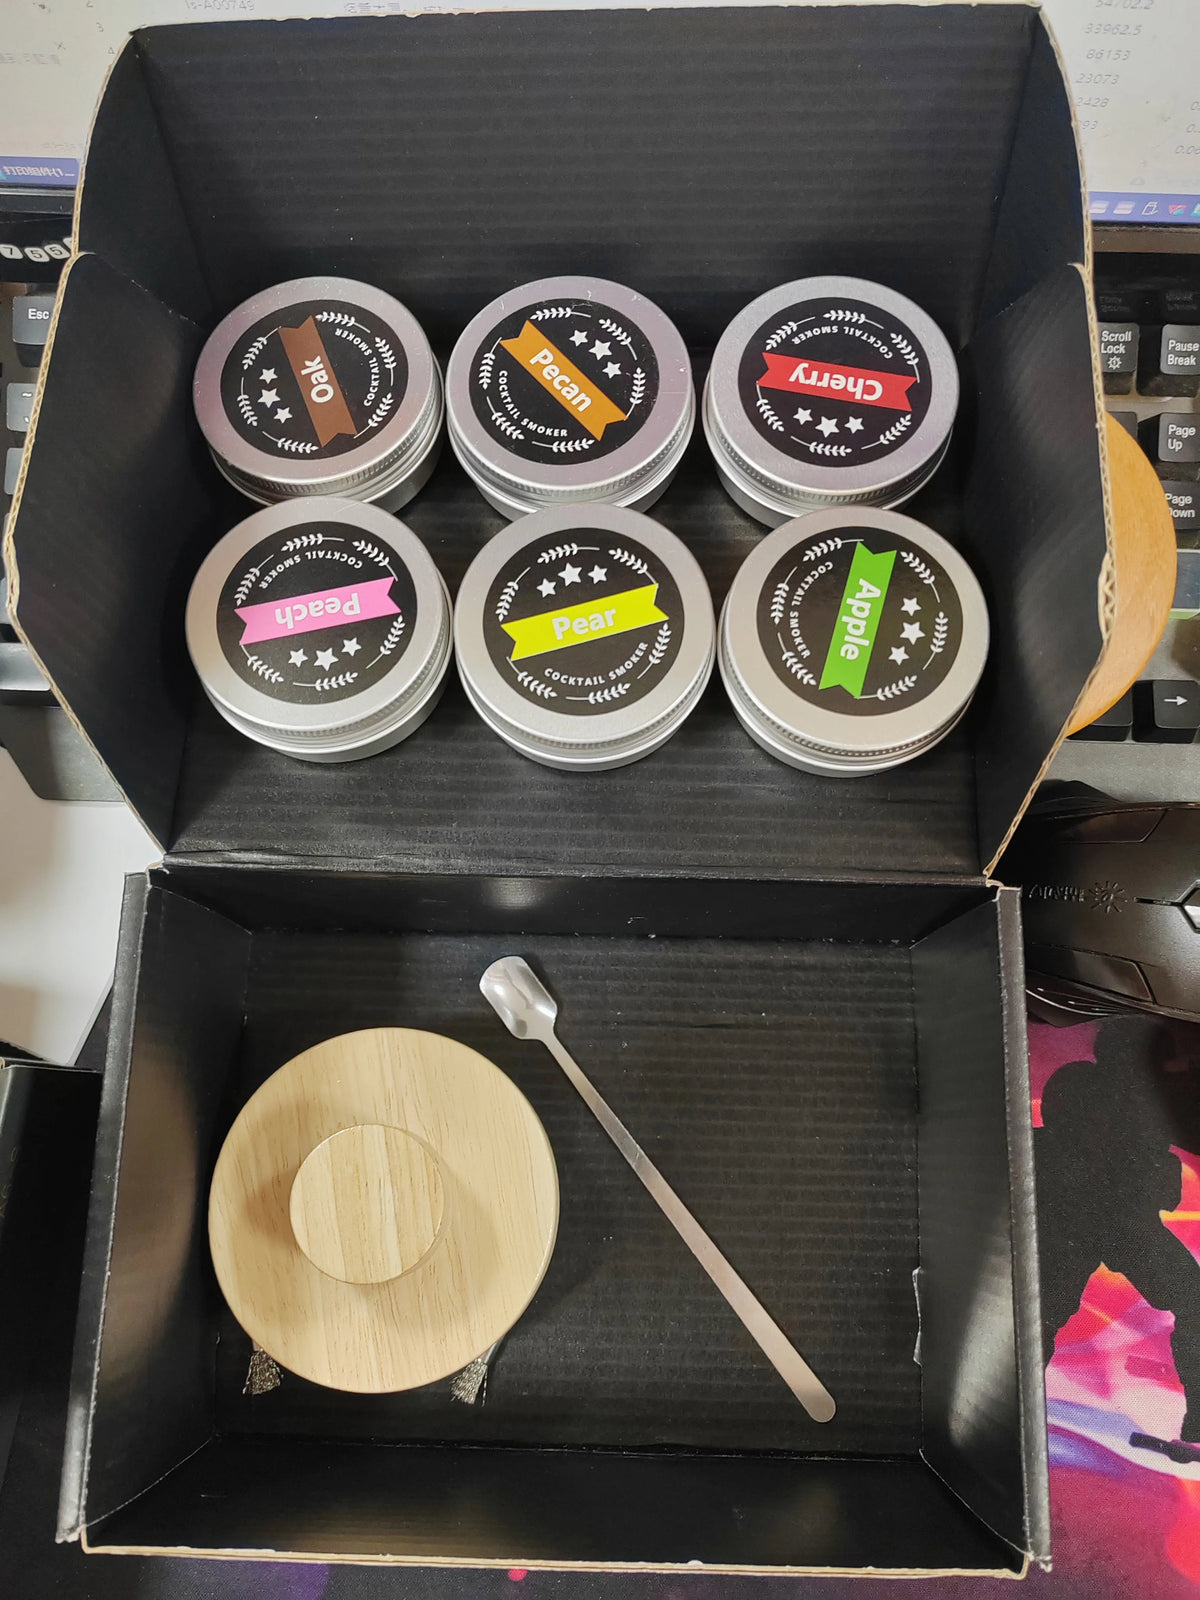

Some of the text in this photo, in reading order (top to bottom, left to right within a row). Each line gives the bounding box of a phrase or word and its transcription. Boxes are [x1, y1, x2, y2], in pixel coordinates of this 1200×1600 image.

[1084, 23, 1144, 36] 33962.5
[1086, 48, 1132, 61] 86153
[1075, 72, 1120, 86] 23073
[28, 308, 49, 320] Esc
[791, 325, 893, 359] COCKTAIL SMOKER
[1101, 330, 1132, 342] Scroll
[1101, 342, 1126, 354] Lock
[1168, 340, 1200, 352] Pause
[334, 327, 380, 407] COCKTAIL SMOKER
[1167, 354, 1197, 366] Break
[300, 355, 334, 403] Oak
[528, 347, 593, 412] Pecan
[788, 362, 883, 401] Cherry
[498, 370, 568, 437] COCKTAIL SMOKER
[1167, 438, 1183, 452] Up
[1168, 424, 1196, 439] Page
[1165, 493, 1192, 507] Page
[258, 550, 363, 589] COCKTAIL SMOKER
[274, 592, 361, 630] Peach
[551, 608, 617, 640] Pear
[789, 561, 834, 659] COCKTAIL SMOKER
[839, 577, 882, 661] Apple
[544, 641, 649, 687] COCKTAIL SMOKER
